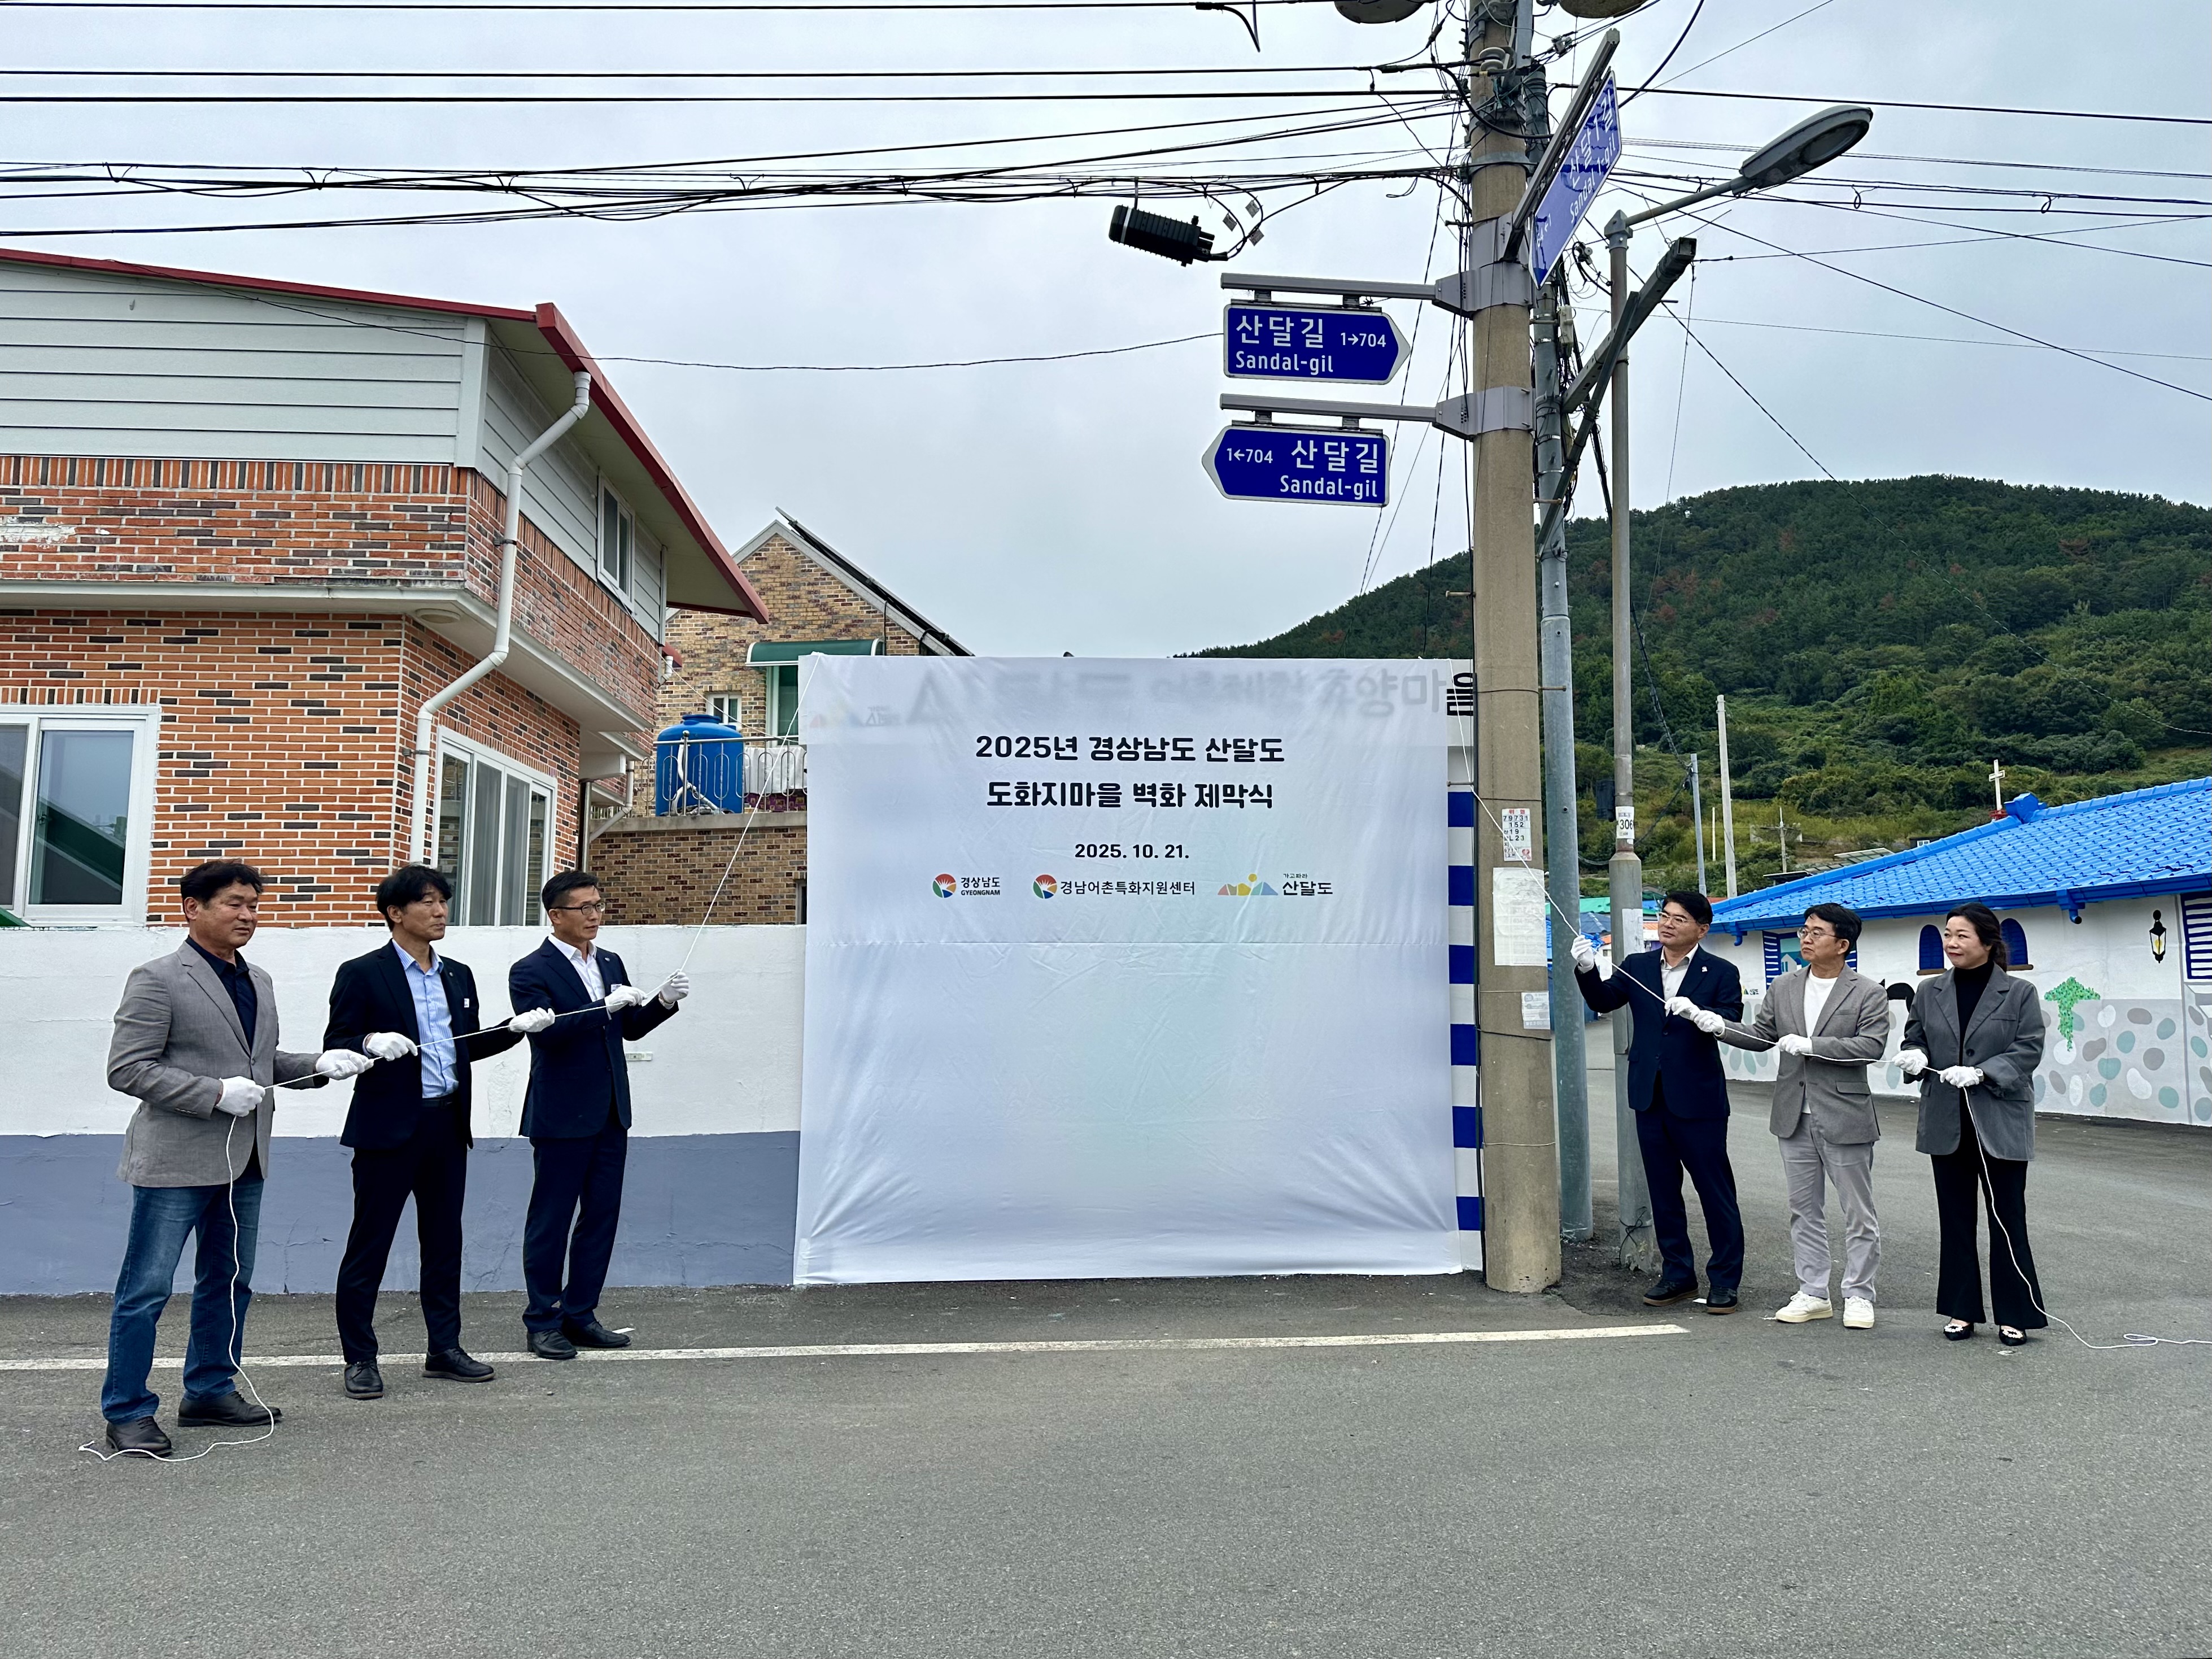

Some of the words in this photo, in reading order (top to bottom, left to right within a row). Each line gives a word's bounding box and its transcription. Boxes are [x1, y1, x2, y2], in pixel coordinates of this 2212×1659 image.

[1570, 168, 1595, 224] Sandal
[1596, 132, 1616, 176] 1-gil
[1236, 315, 1324, 349] 산달길
[1236, 351, 1333, 375] Sandal-gil
[1291, 439, 1378, 473] 산달길
[1280, 475, 1377, 500] Sandal-gil
[976, 735, 1079, 761] 2025년
[1089, 737, 1196, 761] 경상남도
[1205, 738, 1285, 763] 산달도
[987, 781, 1123, 808] 도화지마을
[1133, 783, 1187, 808] 벽화
[1194, 783, 1273, 809] 제막식
[1075, 843, 1127, 859] 2025.
[1132, 844, 1159, 859] 10.
[1164, 844, 1189, 859] 21.
[961, 877, 1000, 889] 경상남도
[1060, 880, 1195, 895] 경남어촌특화지원센터
[1282, 881, 1333, 896] 산달도
